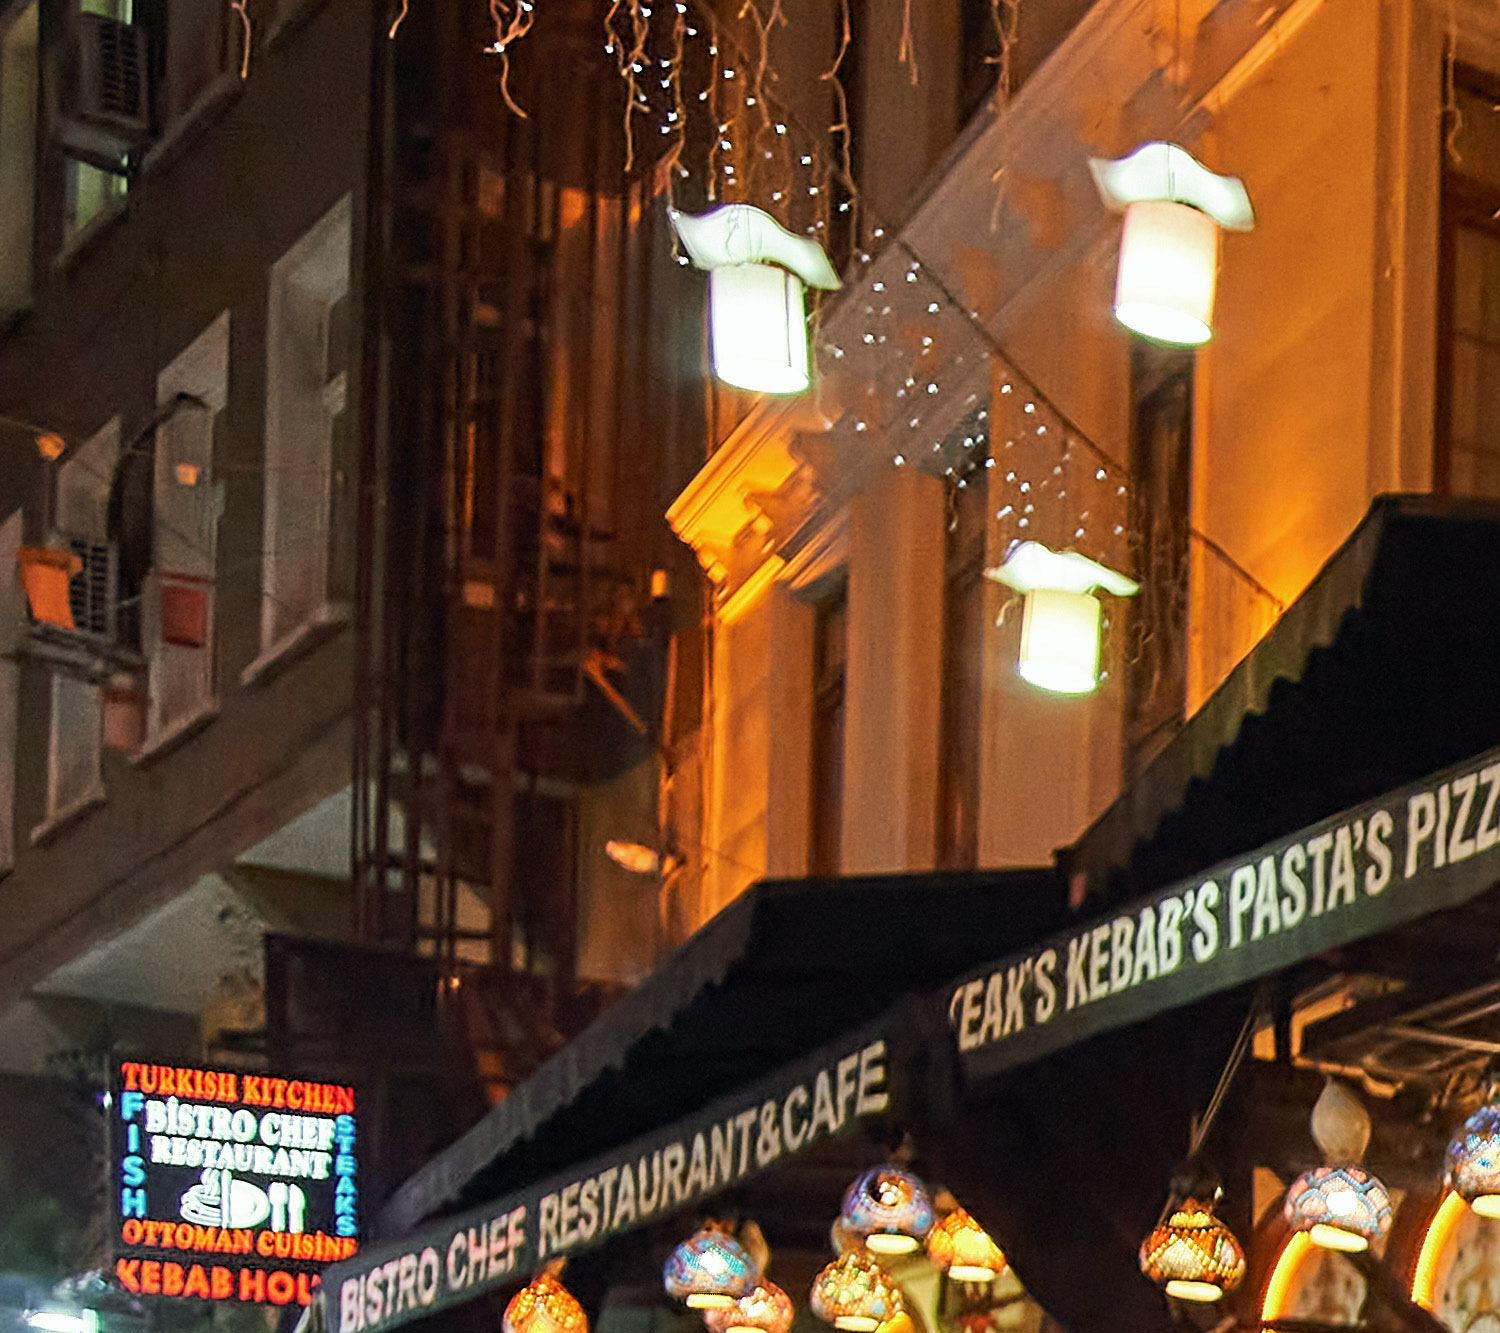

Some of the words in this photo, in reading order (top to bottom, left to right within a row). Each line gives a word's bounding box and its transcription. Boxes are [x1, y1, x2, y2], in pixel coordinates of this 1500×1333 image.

[949, 949, 1057, 1052] EAK'S
[1066, 878, 1219, 1011] KEBAB'S
[1228, 811, 1393, 949] PASTA'S
[121, 1062, 238, 1103] TURKISH
[242, 1075, 355, 1114] KITCHEN
[121, 1092, 147, 1218] FISH
[151, 1135, 333, 1180] RESTAURANT
[259, 1112, 336, 1151] CHEF
[335, 1114, 357, 1236] STEAKS
[446, 1204, 527, 1294] CHEF
[537, 1039, 890, 1258] RESTAURANT&CAFE
[121, 1218, 253, 1254] OTTOMAN
[115, 1258, 234, 1299] KEBAB
[239, 1268, 322, 1305] HOU
